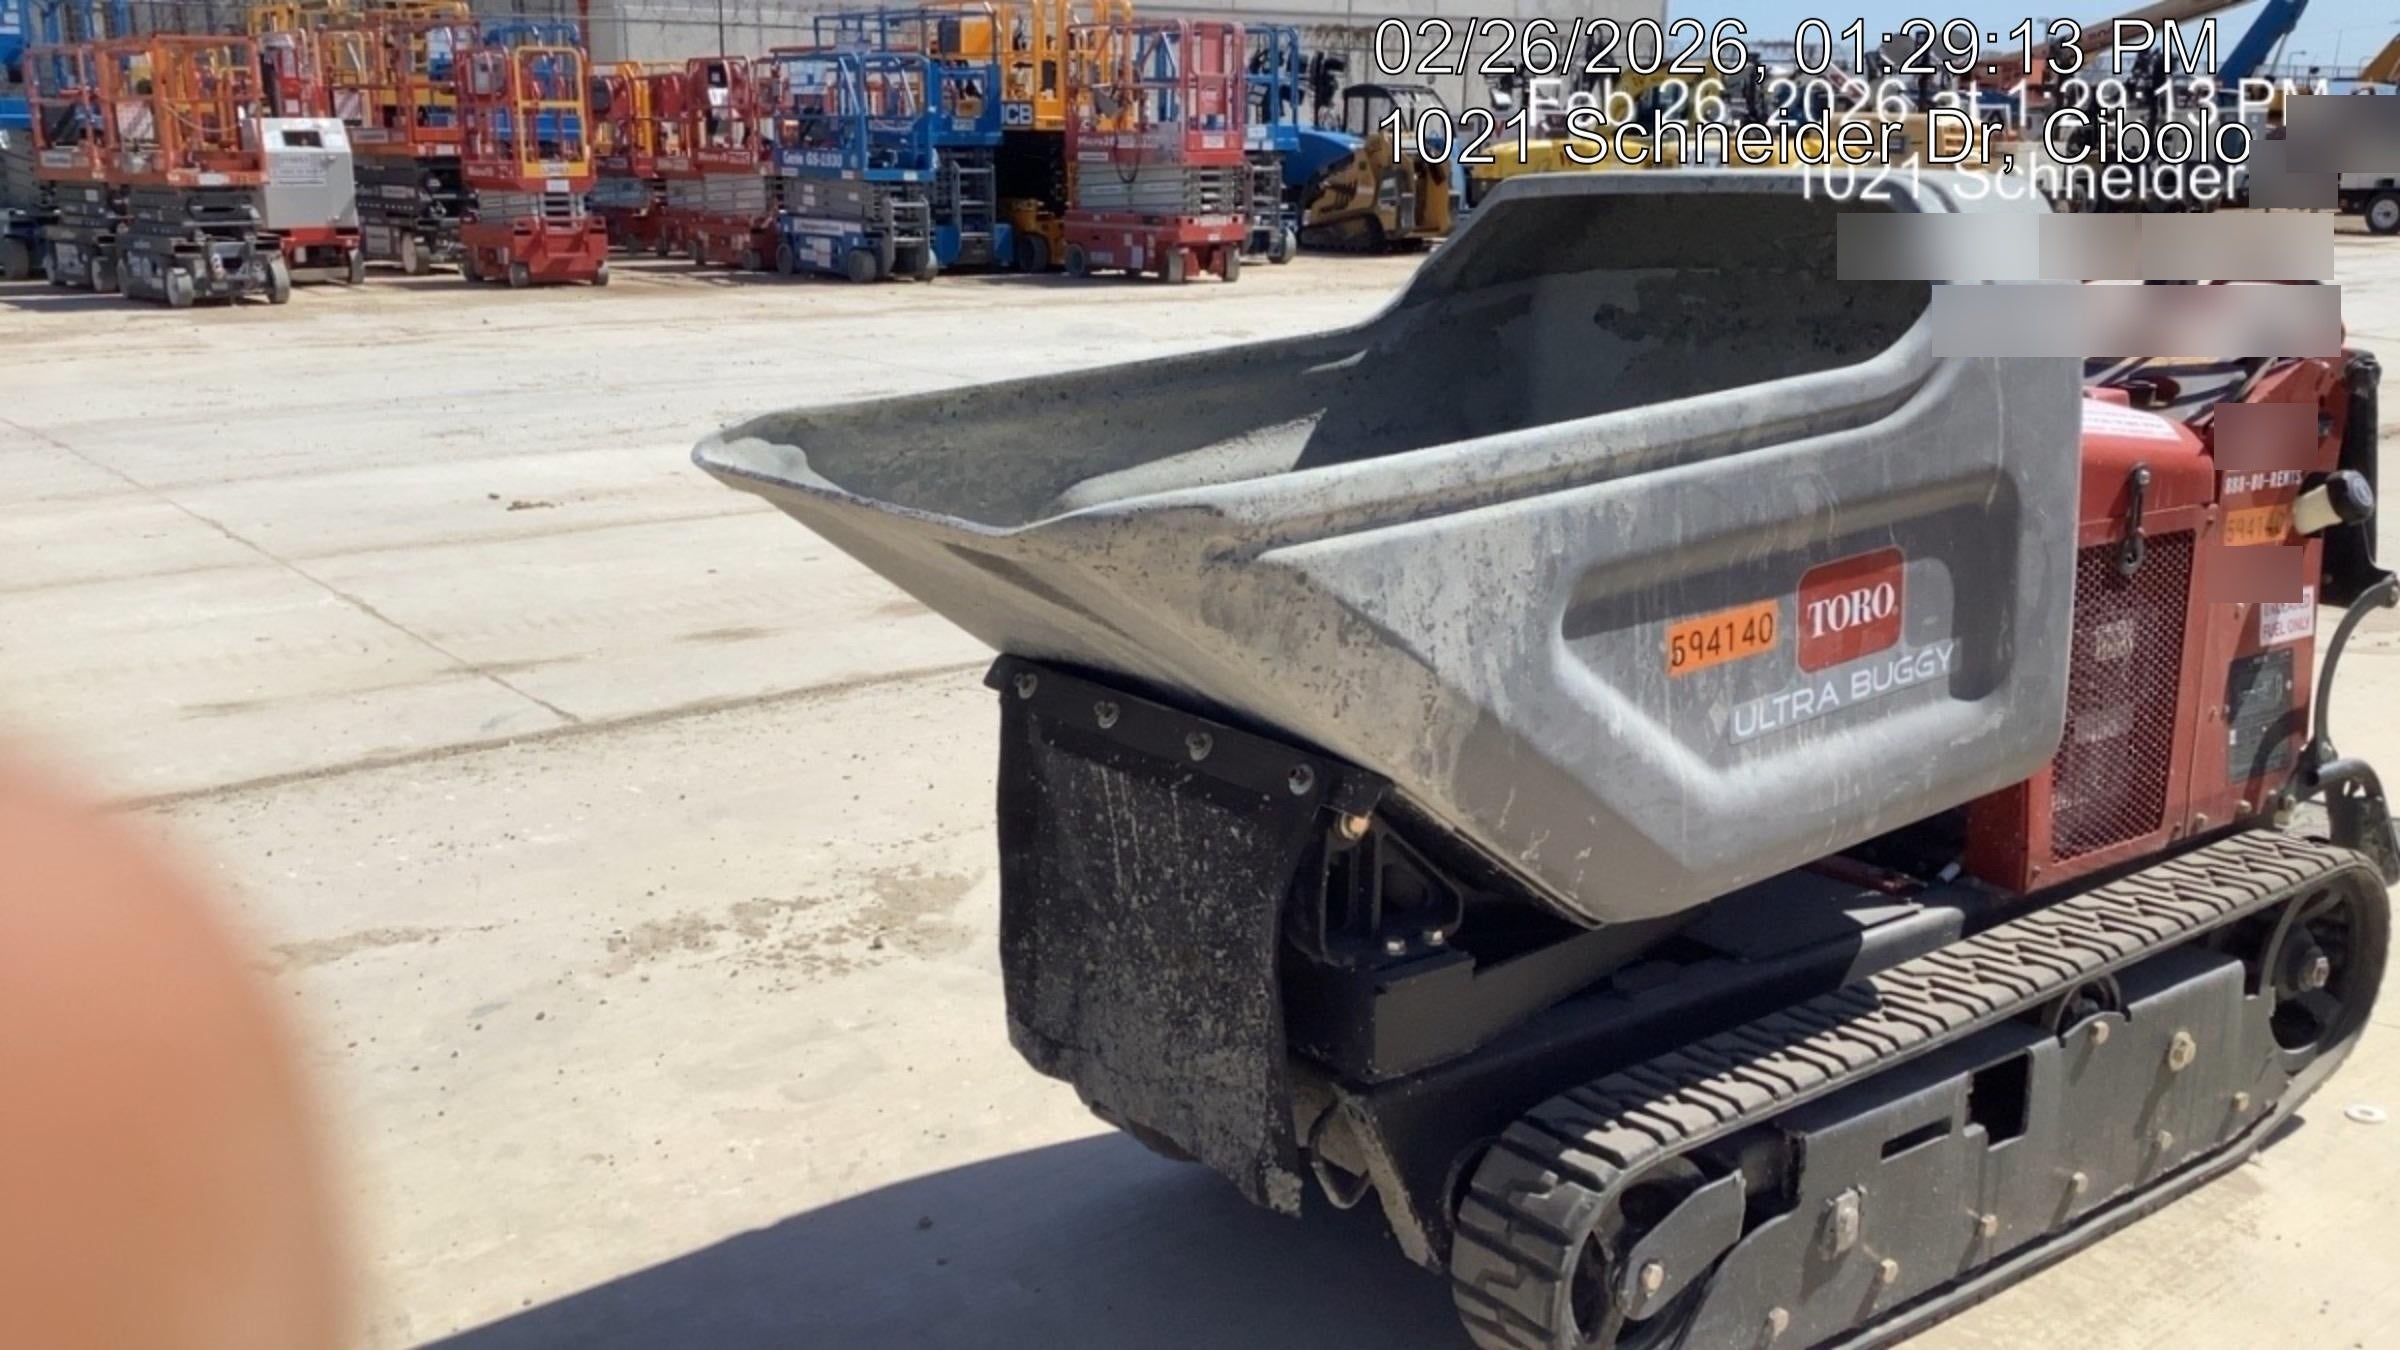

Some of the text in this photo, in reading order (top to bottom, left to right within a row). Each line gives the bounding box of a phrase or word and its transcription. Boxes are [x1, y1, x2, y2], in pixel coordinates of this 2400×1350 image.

[1671, 612, 1774, 667] 594140
[1807, 581, 1896, 640] TORO
[1733, 642, 1954, 738] ULTRA BUGGY
